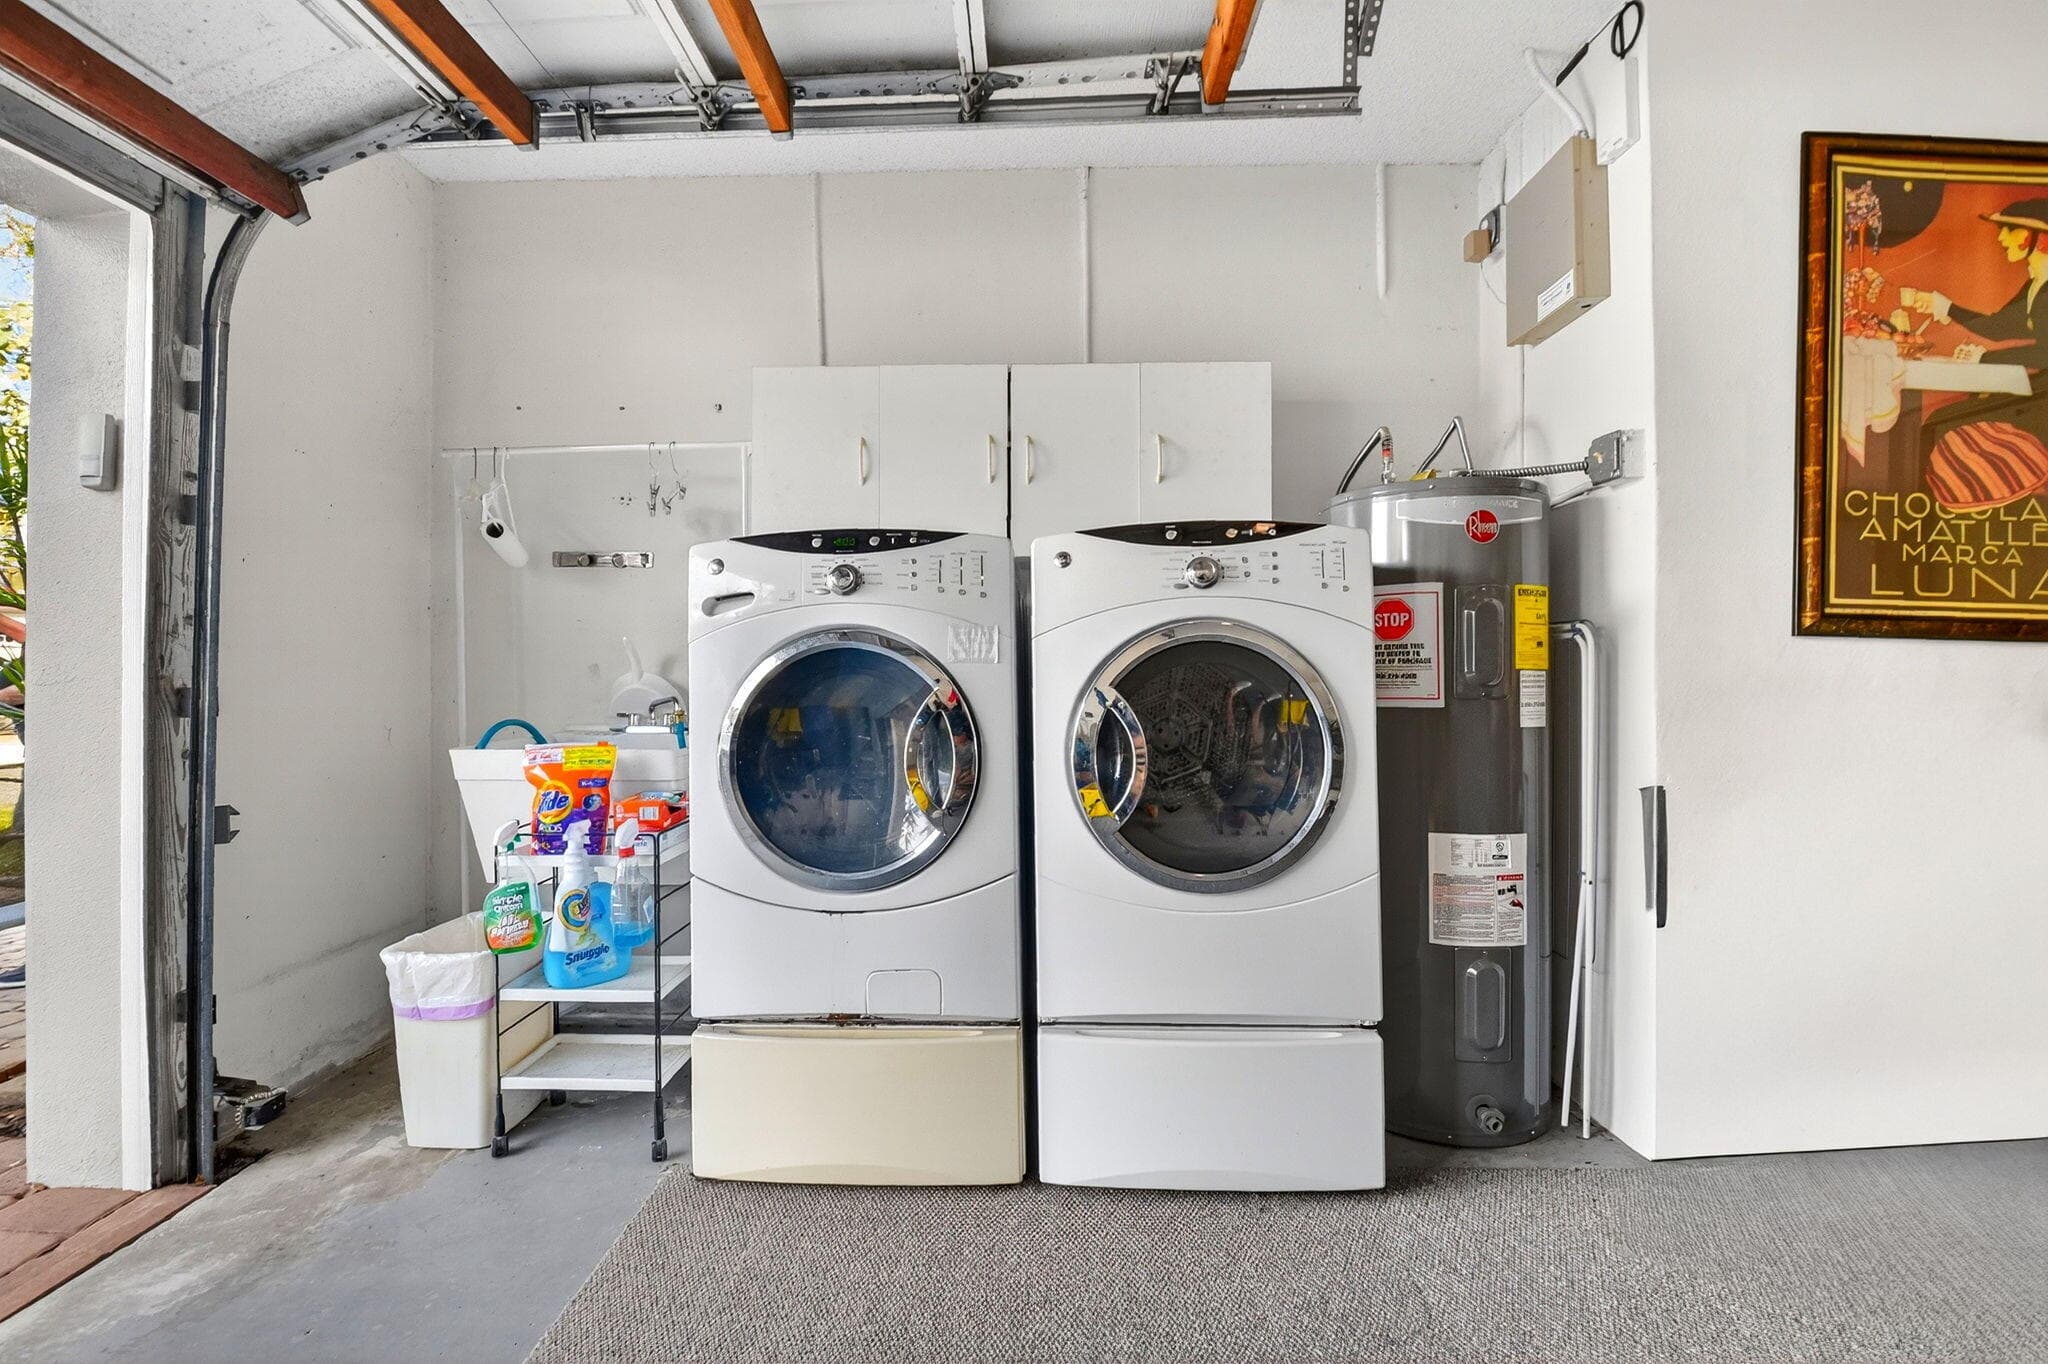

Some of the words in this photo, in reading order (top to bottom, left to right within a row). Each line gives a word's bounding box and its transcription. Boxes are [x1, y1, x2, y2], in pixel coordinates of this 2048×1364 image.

[1902, 543, 2023, 565] MARCA
[1375, 612, 1410, 628] STOP
[538, 790, 570, 813] Tide
